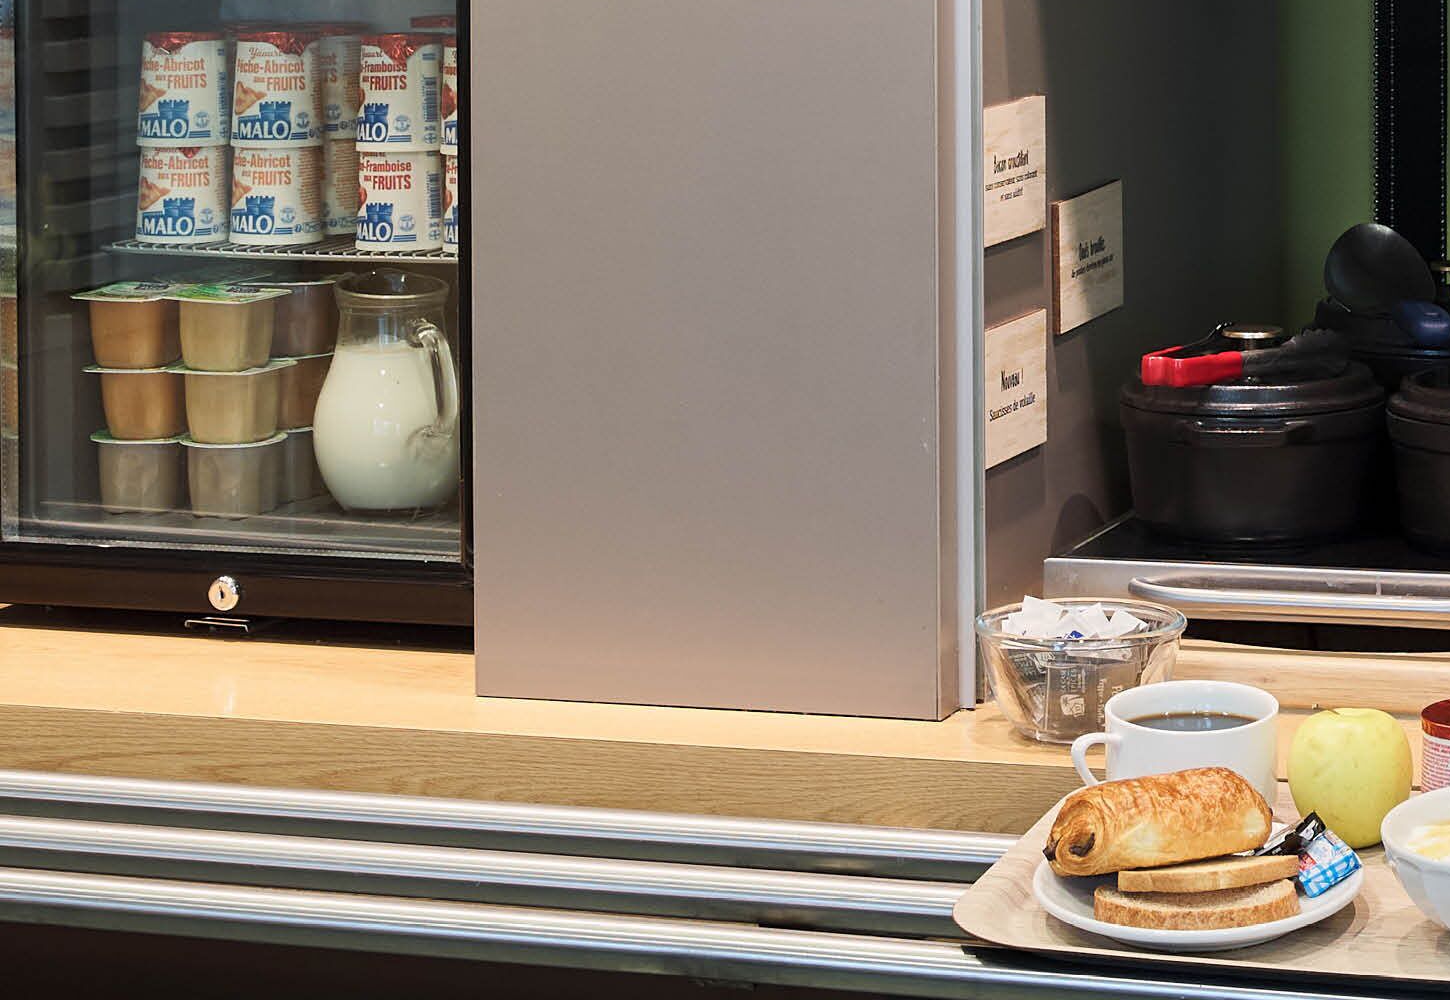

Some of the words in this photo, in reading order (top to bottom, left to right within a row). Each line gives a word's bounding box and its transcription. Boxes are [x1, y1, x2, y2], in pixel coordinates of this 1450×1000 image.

[168, 73, 208, 89] FRUITS
[266, 75, 306, 92] FRUITS
[369, 74, 407, 91] FRUITS
[141, 118, 188, 138] MALO
[239, 120, 290, 141] MALO
[170, 171, 210, 188] FRUITS
[252, 170, 292, 187] FRUITS
[372, 174, 412, 191] FRUITS
[143, 216, 194, 236] MALO
[232, 214, 273, 234] MALO
